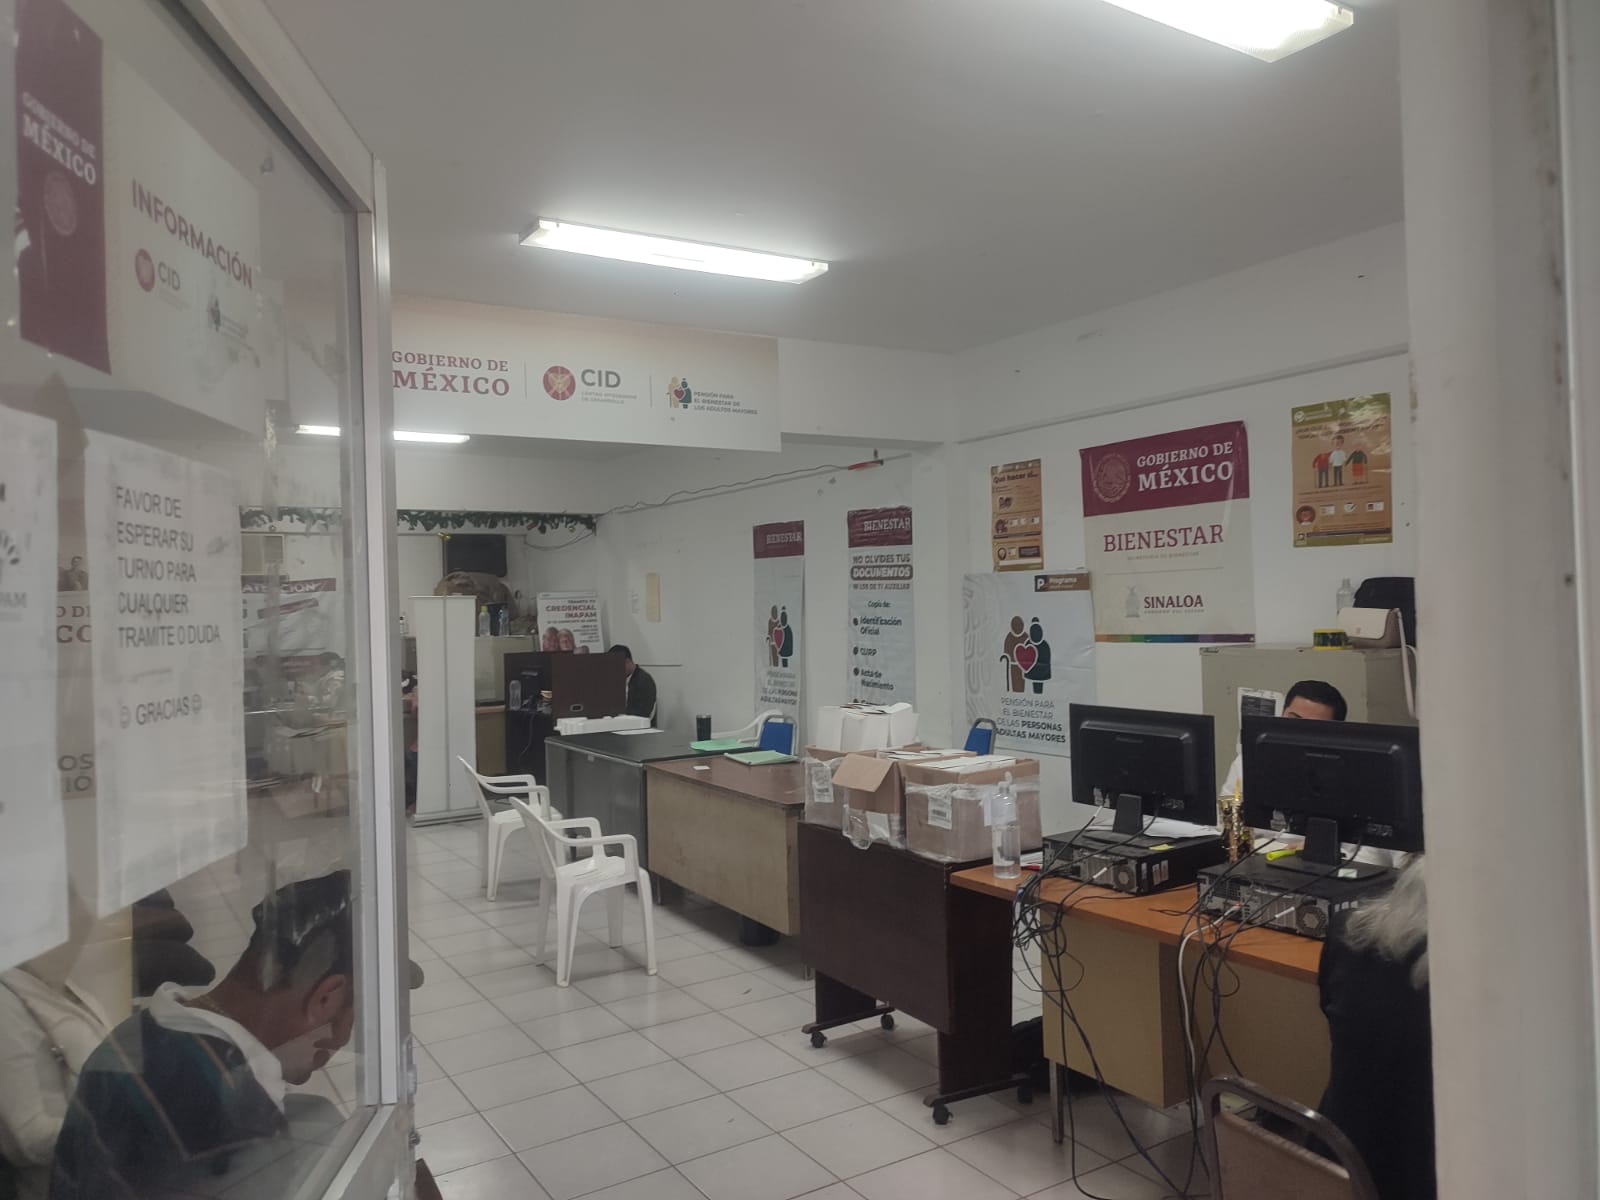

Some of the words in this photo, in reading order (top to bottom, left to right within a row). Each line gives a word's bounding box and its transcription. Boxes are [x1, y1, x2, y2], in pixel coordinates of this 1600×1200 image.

[22, 91, 80, 147] GOBIERNO
[81, 138, 95, 159] DE
[23, 114, 96, 185] MÉXICO
[132, 178, 252, 289] INFORMACIÓN
[158, 262, 181, 291] CID
[392, 351, 482, 369] GOBIERNO
[487, 360, 509, 372] DE
[392, 367, 510, 396] MÉXICO
[581, 369, 621, 388] CID
[1136, 446, 1209, 468] GOBIERNO
[1213, 441, 1233, 456] DE
[1138, 461, 1233, 492] MÉXICO
[116, 486, 161, 514] FAVOR
[164, 496, 182, 519] DE
[863, 518, 911, 532] BIENESTAR
[117, 521, 178, 550] ESPERAR
[180, 531, 193, 552] SU
[766, 531, 801, 545] BIENESTAR
[1103, 524, 1224, 552] BIENESTAR
[853, 555, 864, 564] NO
[865, 553, 895, 564] OLVIDES
[896, 553, 911, 563] TUS
[118, 557, 164, 580] TURNO
[167, 561, 197, 582] PARA
[852, 565, 911, 578] DOCUMENTOS
[118, 592, 189, 614] CUALQUIER
[545, 604, 597, 612] CREDENCIAL
[1143, 594, 1204, 609] SINALOA
[860, 616, 902, 626] Identificación
[860, 626, 881, 635] Oficial
[118, 625, 175, 648] TRAMITE
[187, 624, 220, 645] DUDA
[860, 647, 877, 656] CURP
[861, 680, 894, 690] Nacimiento
[136, 696, 190, 726] GRACIAS
[1001, 696, 1034, 707] PENSIÓN
[1034, 699, 1055, 709] PARA
[1012, 709, 1054, 719] BIENESTAR
[995, 728, 1027, 739] ADULTAS
[1028, 731, 1067, 743] MAYORES
[1006, 720, 1020, 728] LAS
[1021, 721, 1063, 732] PERSONAS
